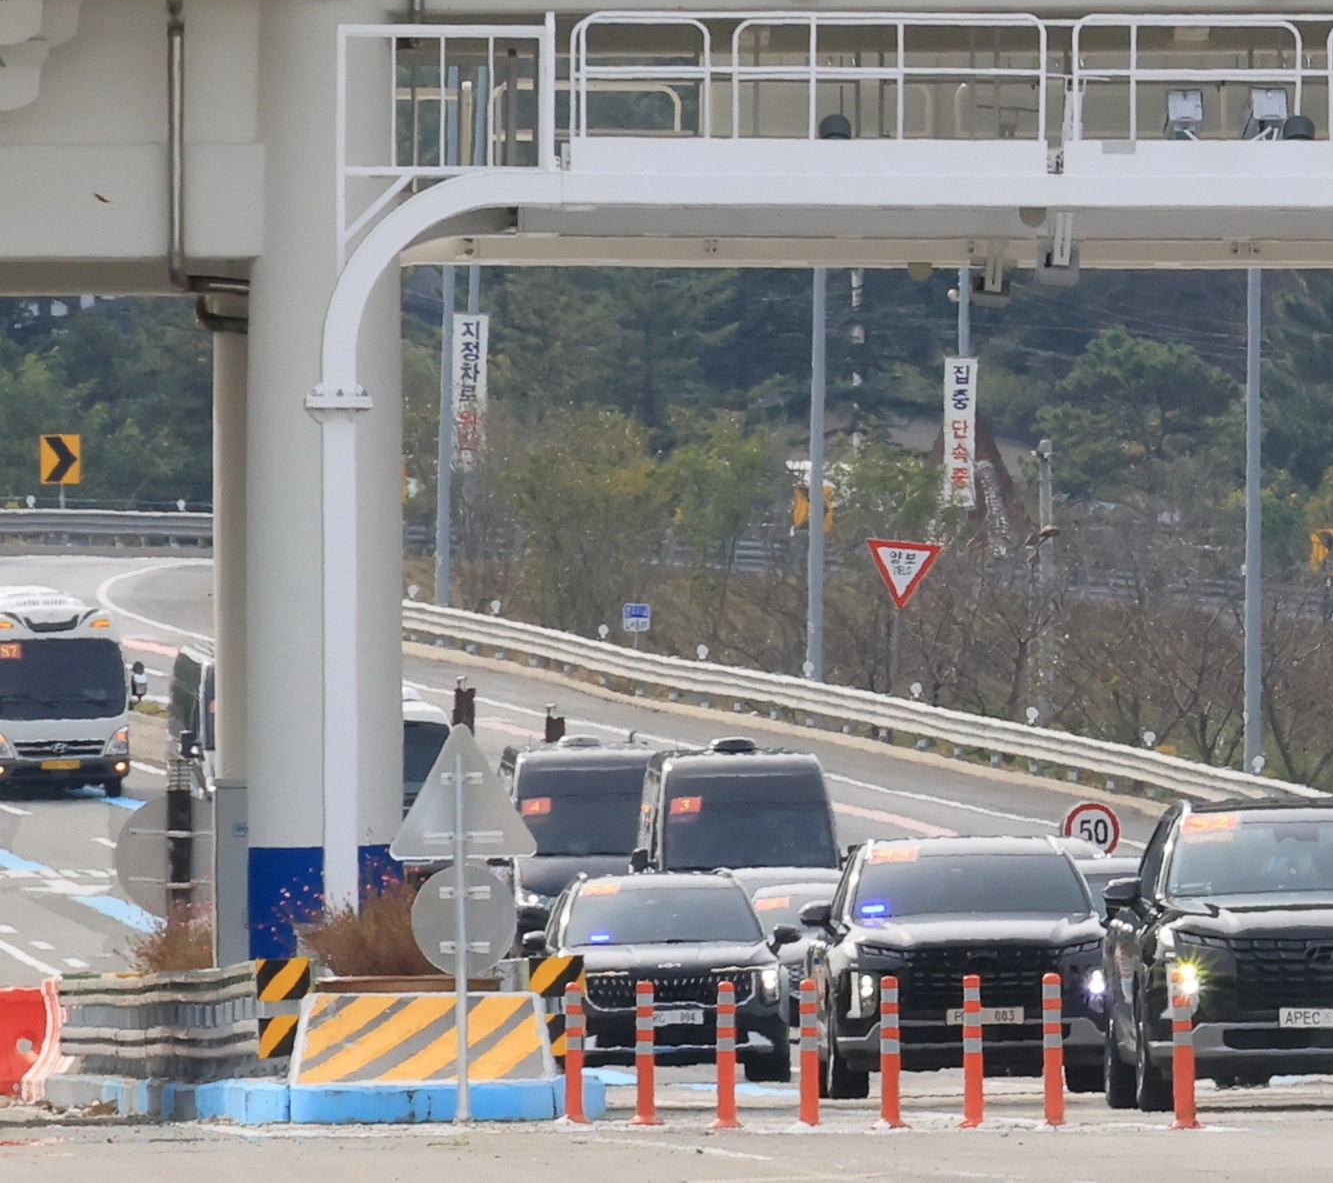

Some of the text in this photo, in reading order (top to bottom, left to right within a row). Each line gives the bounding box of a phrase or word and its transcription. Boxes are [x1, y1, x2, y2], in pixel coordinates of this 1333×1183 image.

[460, 321, 480, 402] 지정차로
[952, 365, 970, 410] 집중
[890, 551, 916, 565] 양보
[1079, 818, 1109, 845] 50
[1285, 1011, 1321, 1026] APEC
